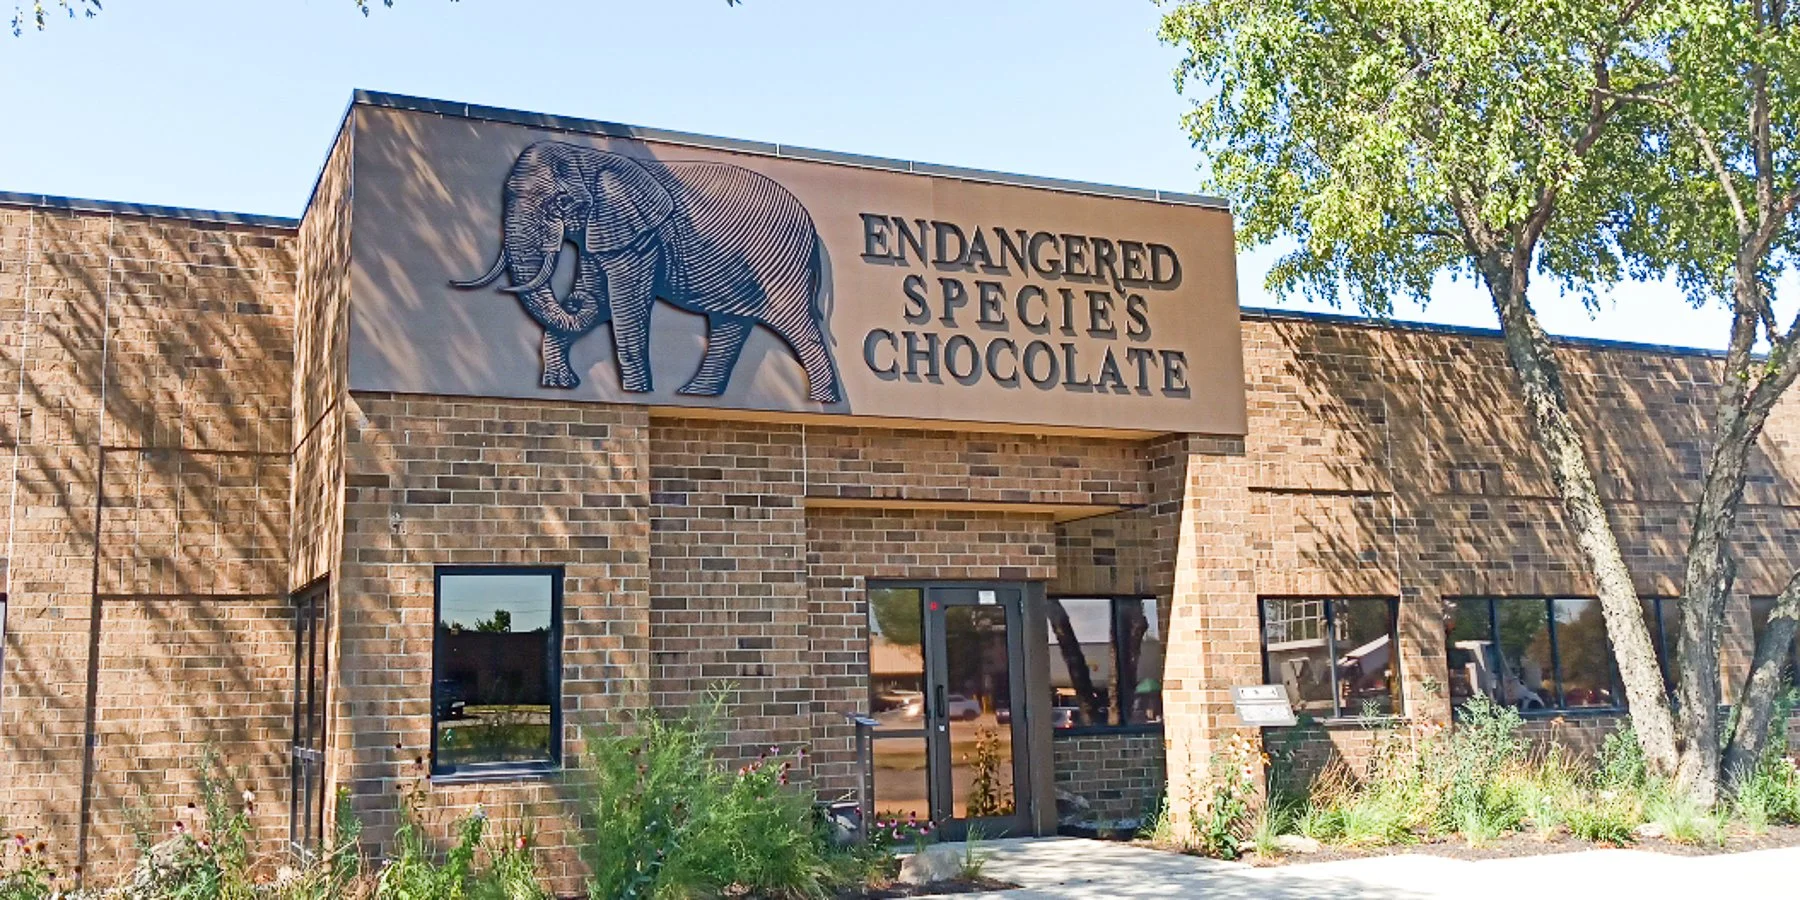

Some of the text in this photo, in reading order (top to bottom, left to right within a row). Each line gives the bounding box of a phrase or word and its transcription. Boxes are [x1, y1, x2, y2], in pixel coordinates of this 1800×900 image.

[859, 212, 1182, 294] ENDANGERED
[903, 274, 1149, 342] SPECIES
[863, 328, 1189, 397] CHOCOLATE
